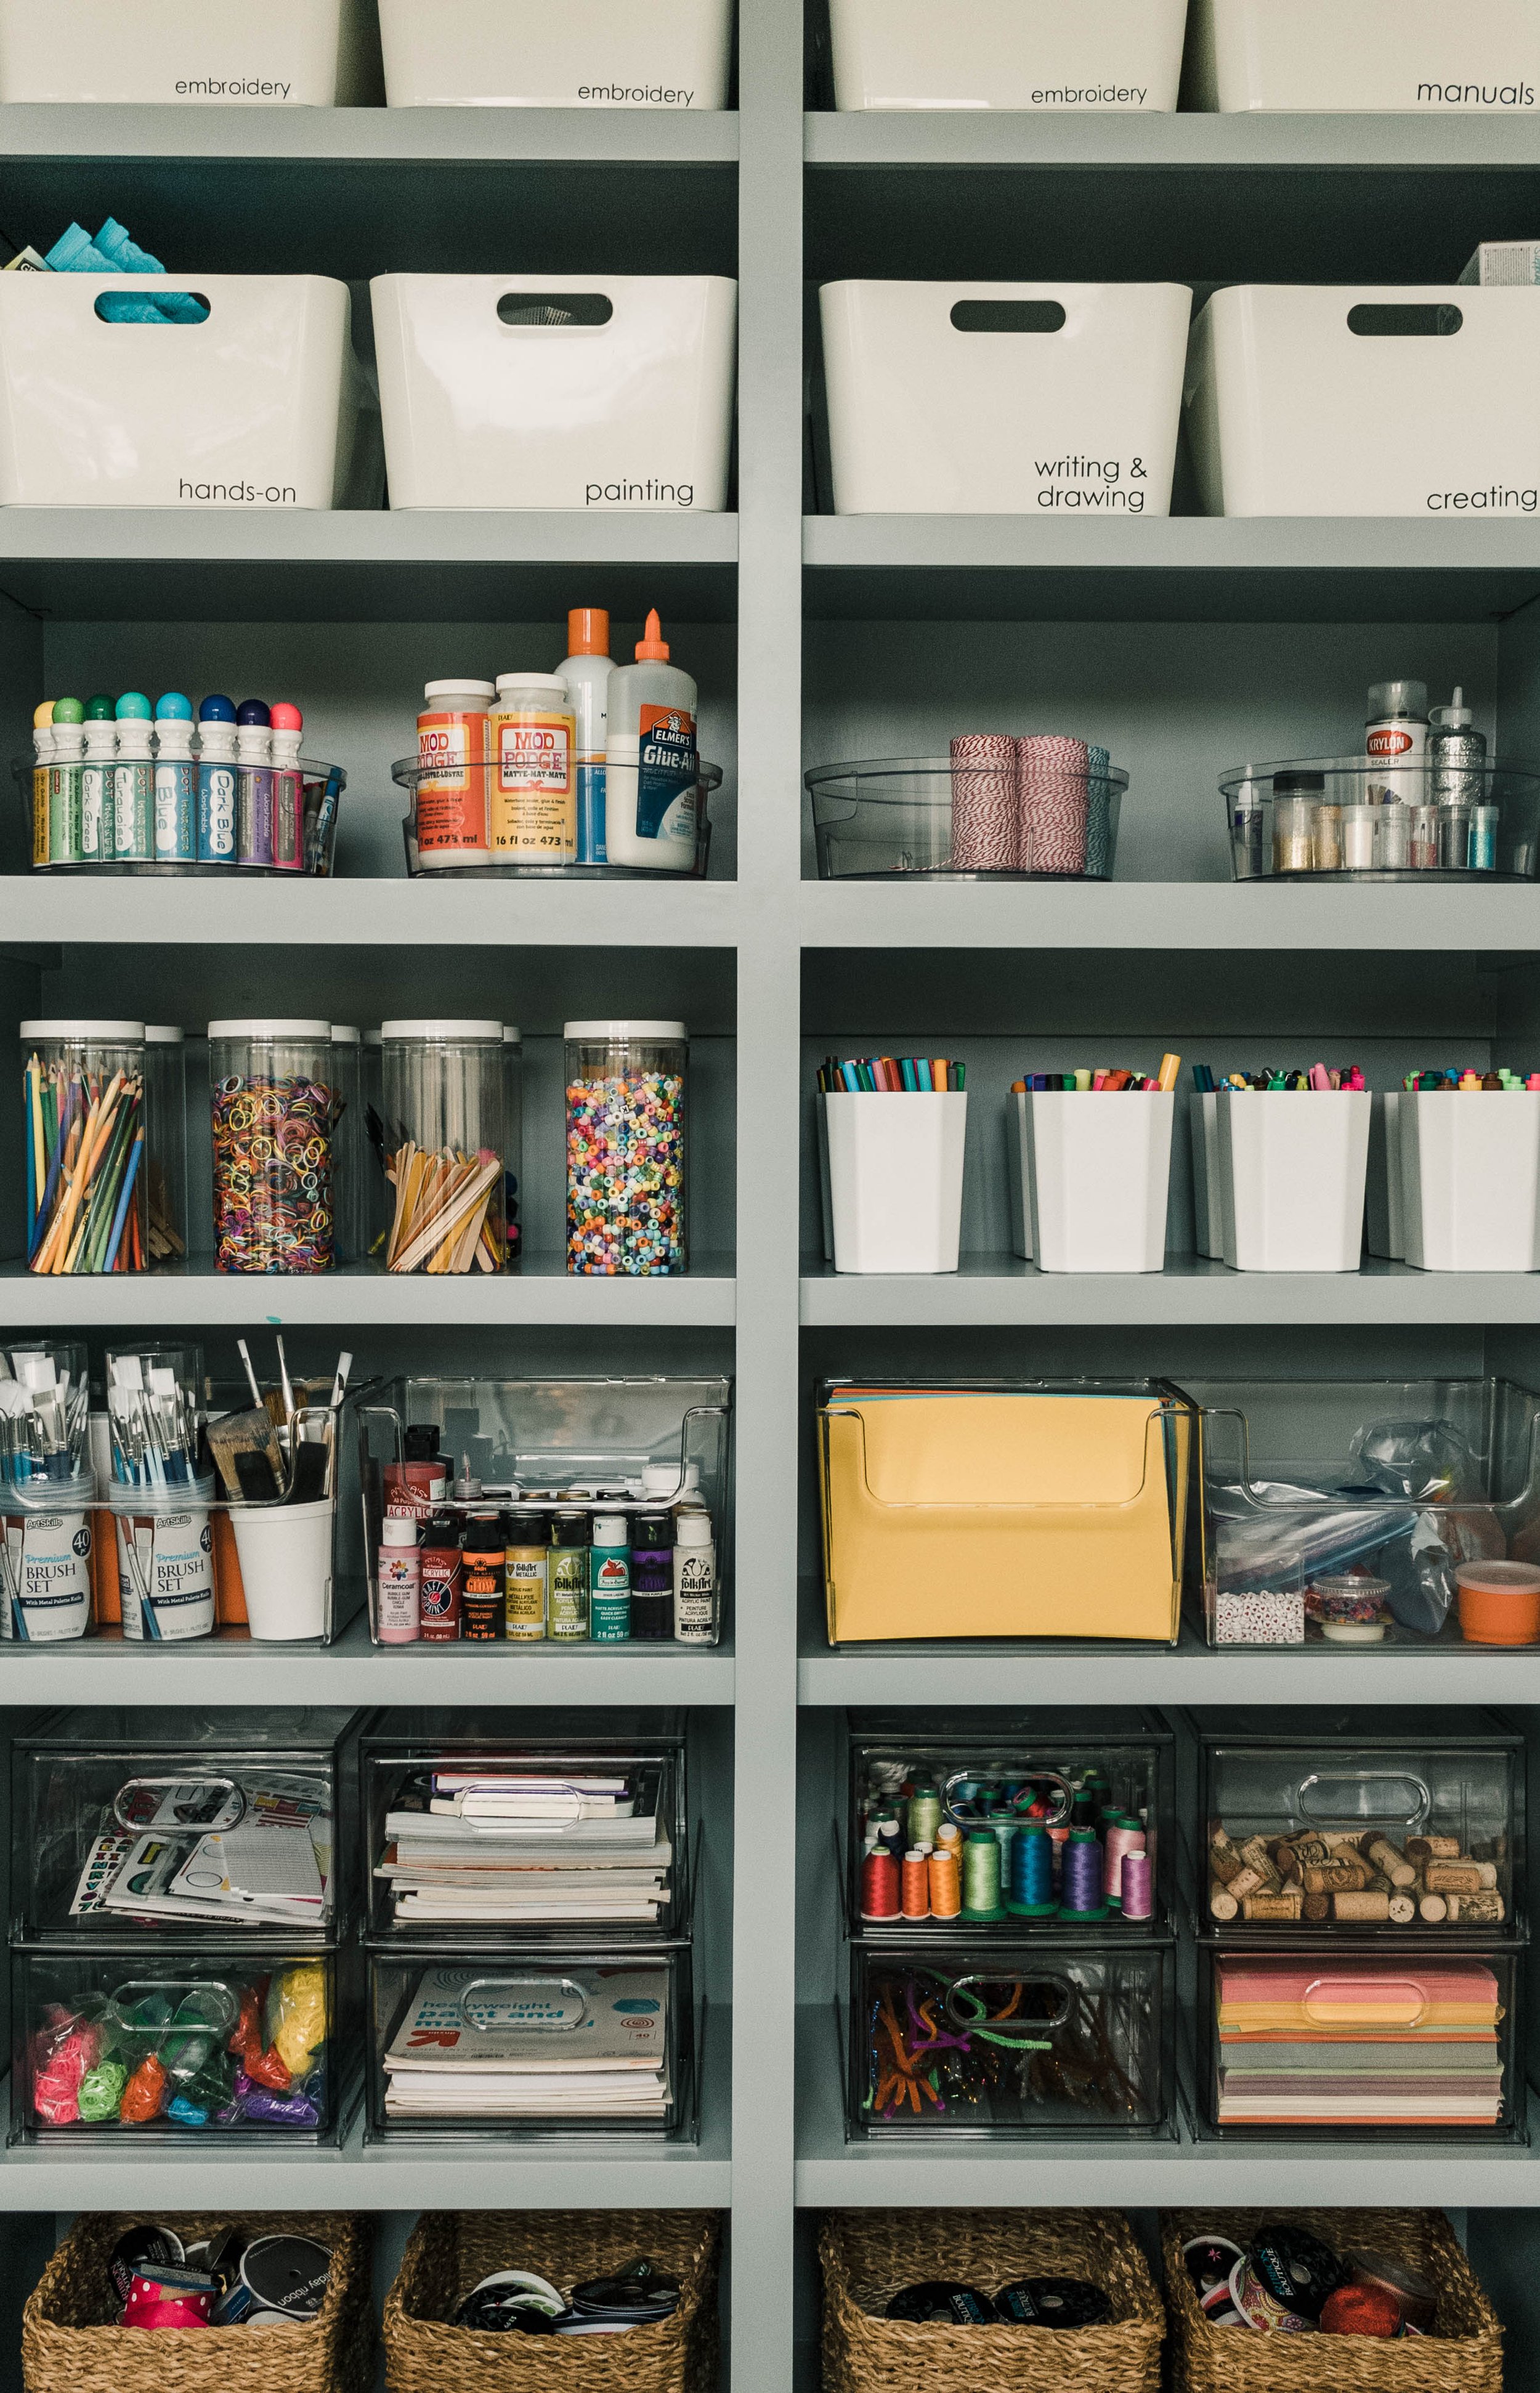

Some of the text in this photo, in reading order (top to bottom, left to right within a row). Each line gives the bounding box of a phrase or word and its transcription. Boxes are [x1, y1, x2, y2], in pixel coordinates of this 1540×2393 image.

[176, 78, 290, 99] embroidery
[578, 84, 694, 106] embroidery
[1032, 85, 1146, 104] embroidery
[1418, 83, 1533, 105] manuals
[1035, 456, 1147, 483] writing &
[180, 479, 295, 502] hands-on
[586, 479, 692, 506] painting
[1038, 486, 1143, 512] drawing
[1427, 486, 1536, 511] creating
[419, 733, 449, 753] MOD
[515, 732, 554, 750] MOD
[655, 730, 690, 746] ELMER'S
[1369, 736, 1404, 751] KRYLON
[505, 751, 562, 770] PODGE
[137, 768, 147, 796] DOT
[181, 767, 190, 796] DOT
[503, 770, 566, 779] MATTE-MAT-MATE
[106, 771, 115, 798] DOT
[158, 786, 172, 830] Blue
[217, 775, 230, 849] Dark Blue
[84, 811, 92, 849] Green
[437, 835, 458, 844] 473
[463, 835, 477, 843] ml
[496, 836, 506, 845] 16
[509, 836, 518, 844] fl
[540, 836, 561, 845] 473
[565, 838, 573, 847] ml
[389, 1506, 432, 1518] ACRYLIC
[26, 1518, 63, 1529] ArtSkills
[156, 1515, 192, 1529] ArtSkills
[73, 1531, 89, 1549] 40
[25, 1553, 71, 1564] Premium
[155, 1551, 200, 1562] Premium
[26, 1563, 76, 1579] BRUSH
[157, 1560, 204, 1578] BRUSH
[26, 1580, 52, 1593] SET
[158, 1577, 184, 1592] SET
[466, 1580, 496, 1593] GLOW
[424, 1603, 445, 1614] PAINT
[423, 2001, 552, 2010] heavyweight
[507, 2010, 564, 2018] and
[1265, 2247, 1294, 2296] BOUTIQUE
[277, 2285, 309, 2306] ribbon
